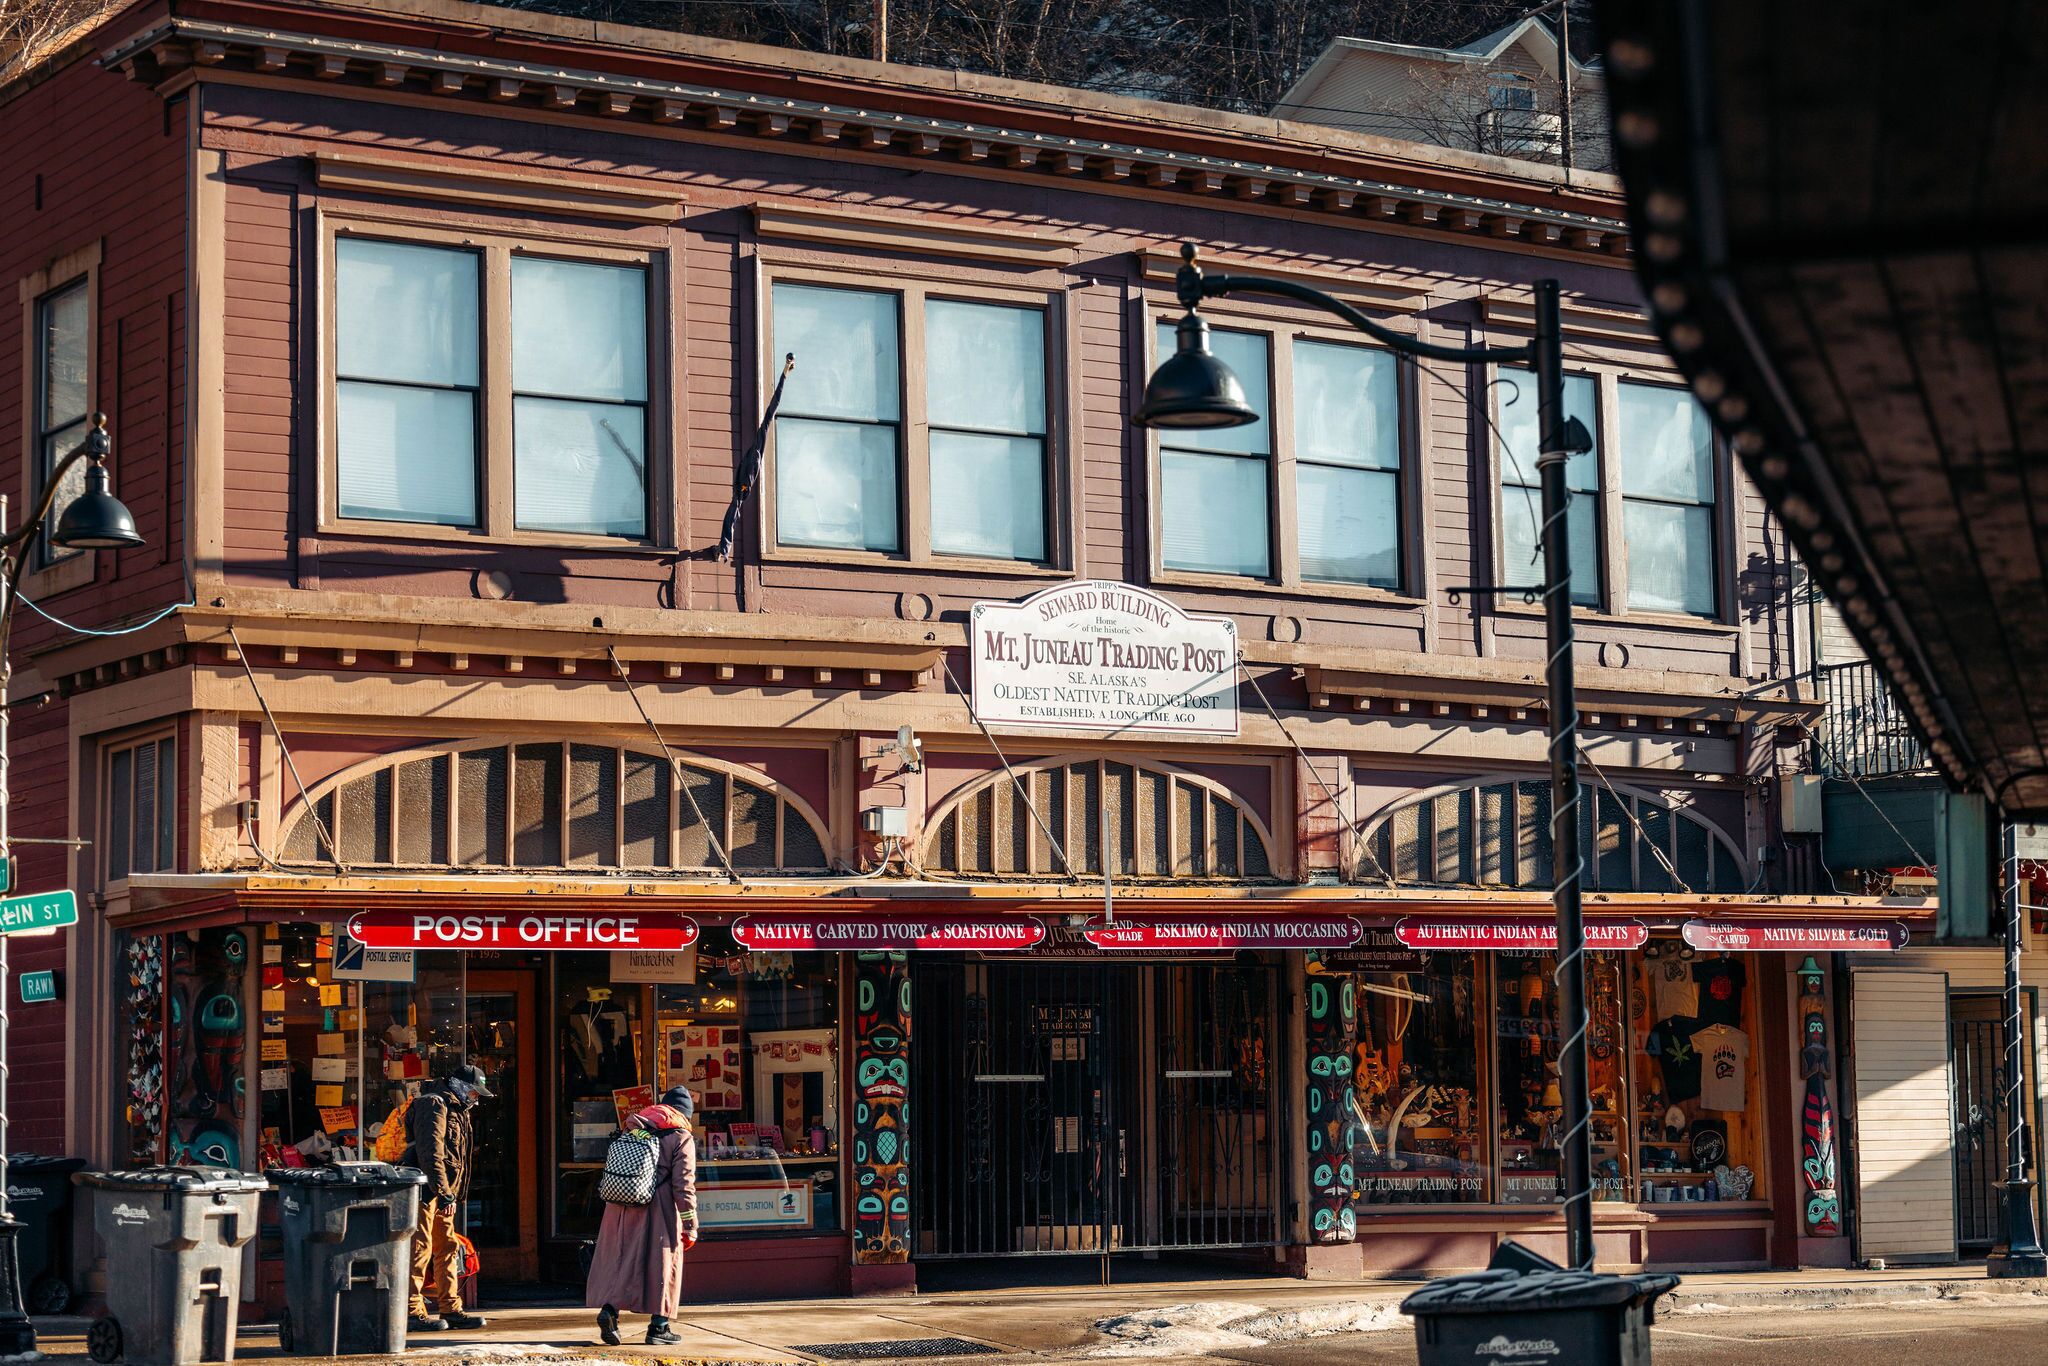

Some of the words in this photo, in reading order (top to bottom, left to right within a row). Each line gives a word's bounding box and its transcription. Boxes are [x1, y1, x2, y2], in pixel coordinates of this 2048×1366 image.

[1038, 592, 1097, 622] SEWARD
[1101, 592, 1172, 629] BUILDING
[1095, 616, 1117, 626] Home
[1082, 625, 1090, 633] of
[1091, 625, 1102, 634] the
[1104, 625, 1131, 635] historic
[1068, 672, 1087, 684] S.E.
[1090, 675, 1147, 688] ALASKA'S
[993, 683, 1051, 700] OLDEST
[1054, 687, 1111, 704] NATIVE
[1113, 690, 1181, 708] TRADING
[1183, 694, 1220, 709] POST
[1098, 711, 1106, 720] A
[1110, 711, 1139, 721] LONG
[1142, 712, 1170, 722] TIME
[1173, 714, 1196, 723] AGO
[43, 904, 60, 920] ST
[413, 915, 506, 942] POST
[518, 917, 640, 944] OFFICE
[754, 923, 813, 939] NATIVE
[816, 923, 878, 939] CARVED
[882, 923, 928, 940] IVORY
[931, 925, 941, 938] &
[944, 923, 1026, 940] SOAPSTONE
[1110, 921, 1134, 931] AND
[1155, 923, 1208, 939] ESKIMO
[1210, 926, 1219, 939] &
[1222, 923, 1270, 939] INDIAN
[1273, 923, 1348, 939] MOCCASINS
[1417, 924, 1490, 939] AUTHENTIC
[1493, 925, 1537, 939] INDIAN
[1583, 925, 1628, 939] CRAFTS
[1710, 924, 1733, 933] HAND
[1117, 931, 1144, 942] MADE
[1719, 934, 1750, 944] CARVED
[1763, 928, 1806, 941] NATIVE
[1808, 928, 1846, 941] SILVER
[1849, 931, 1856, 940] &
[1858, 928, 1888, 941] GOLD
[366, 951, 387, 962] POSTAL
[388, 951, 411, 962] SERVICE
[1358, 1178, 1375, 1191] MT
[1375, 1178, 1413, 1191] JUNEAU
[1416, 1178, 1458, 1191] TRADING
[1460, 1178, 1483, 1190] POST
[1507, 1178, 1521, 1190] MT
[1523, 1178, 1558, 1191] JUNEAU
[1603, 1178, 1625, 1190] POST
[716, 1202, 742, 1211] POSTAL
[745, 1201, 774, 1209] STATION
